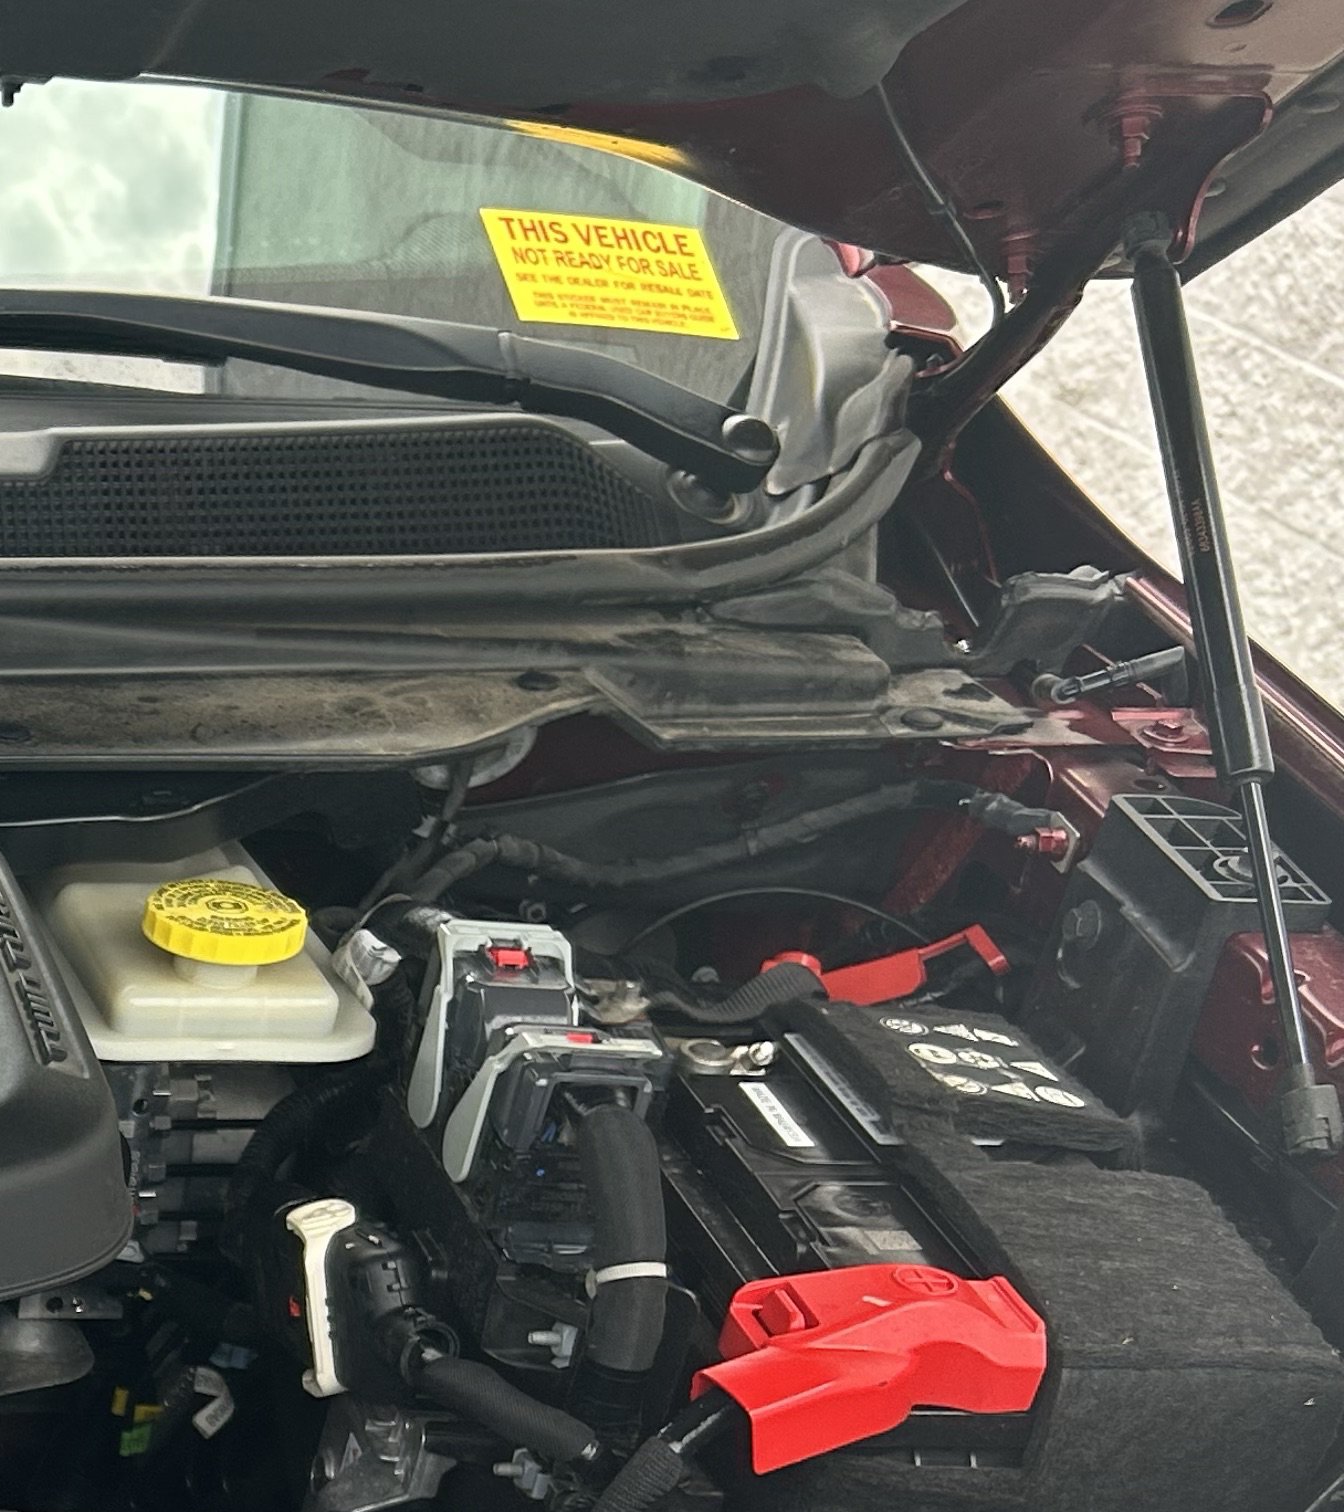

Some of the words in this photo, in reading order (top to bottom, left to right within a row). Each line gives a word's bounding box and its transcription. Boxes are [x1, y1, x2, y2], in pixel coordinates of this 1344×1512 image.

[498, 216, 570, 245] THIS
[571, 222, 695, 257] VEHICLE
[510, 246, 552, 266] NOT
[552, 250, 614, 271] READY
[615, 256, 653, 274] FOR
[654, 259, 703, 280] SALE
[514, 272, 538, 282] SEE
[541, 274, 562, 284] THE
[566, 276, 609, 288] DEALER
[613, 281, 635, 290] FOR
[639, 283, 682, 295] RESALE
[686, 288, 714, 299] DATE
[16, 971, 67, 1064] TWIN
